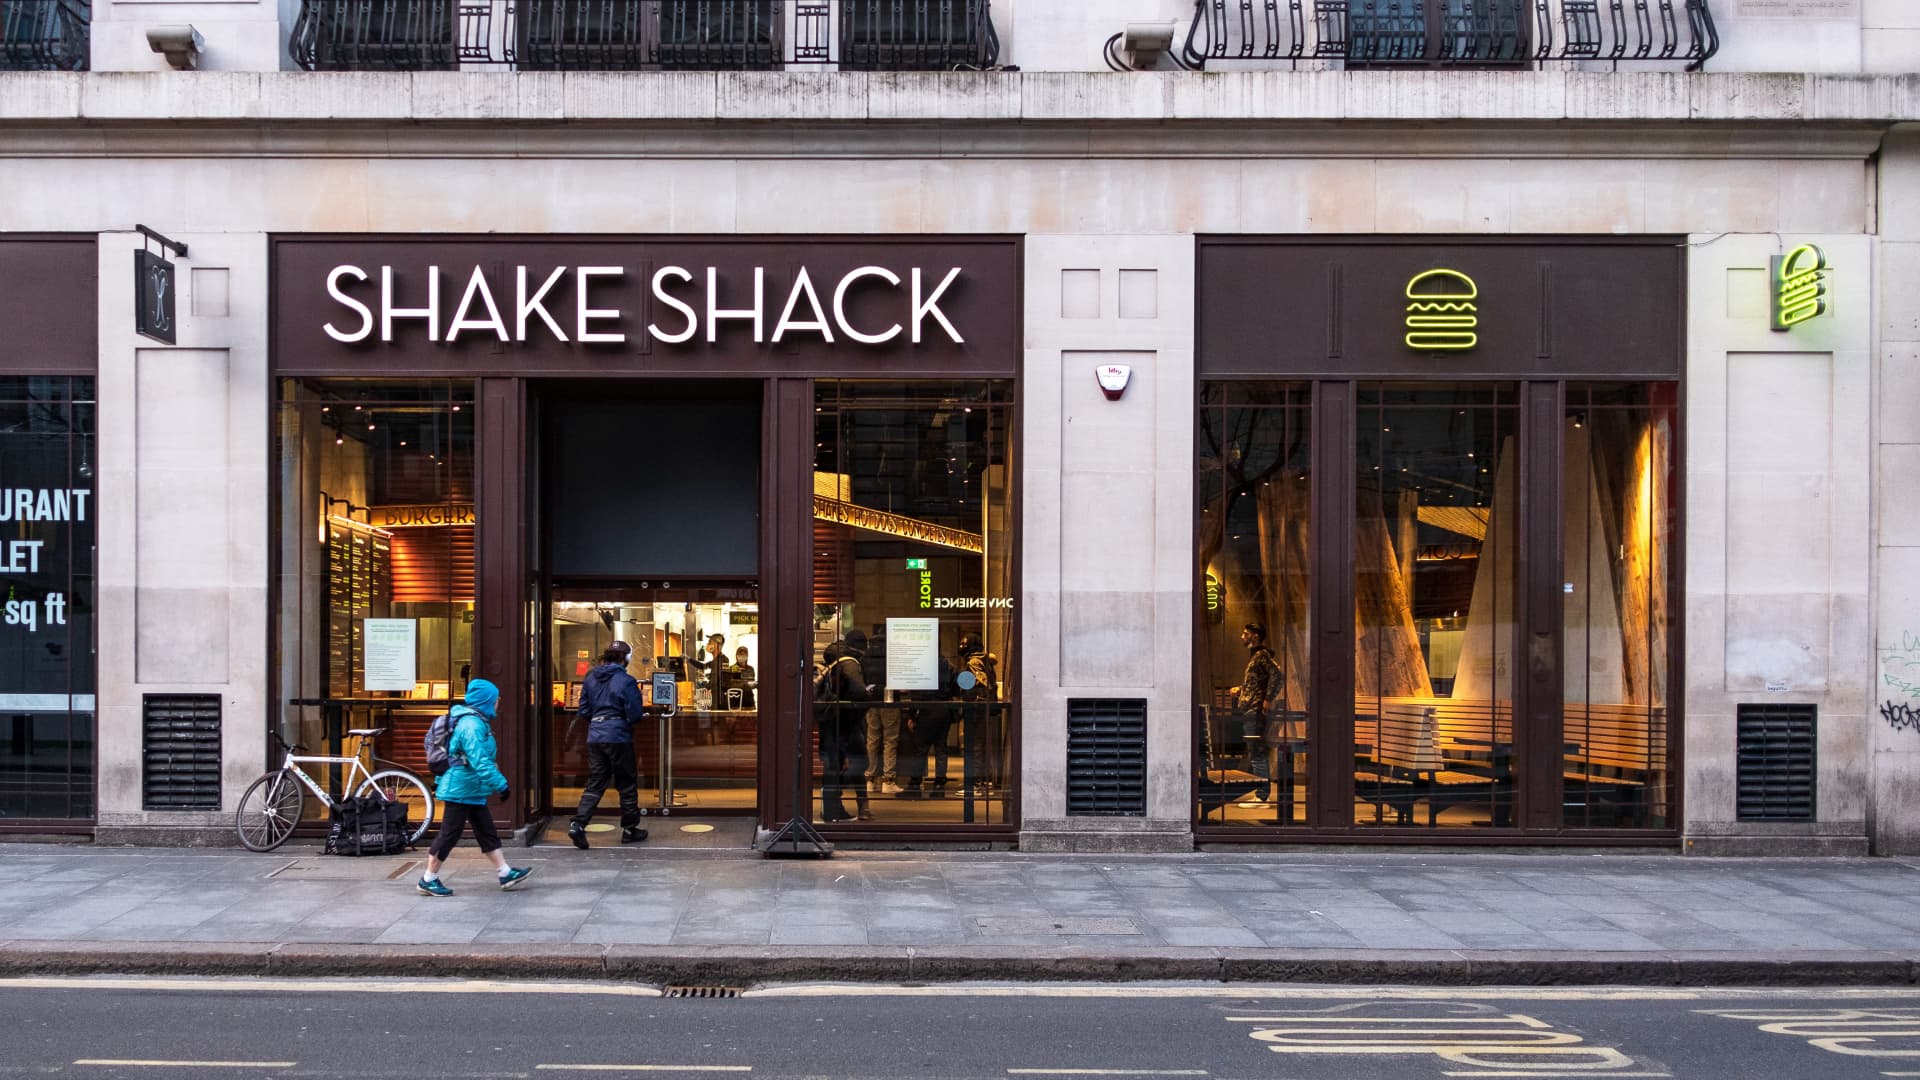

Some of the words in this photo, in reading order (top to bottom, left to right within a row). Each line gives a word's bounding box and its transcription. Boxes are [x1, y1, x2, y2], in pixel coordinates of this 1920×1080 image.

[323, 264, 624, 343] SHAKE
[647, 264, 965, 344] SHACK
[0, 488, 91, 521] URANT
[0, 540, 43, 573] LET
[5, 600, 37, 632] sq
[44, 592, 66, 625] ft
